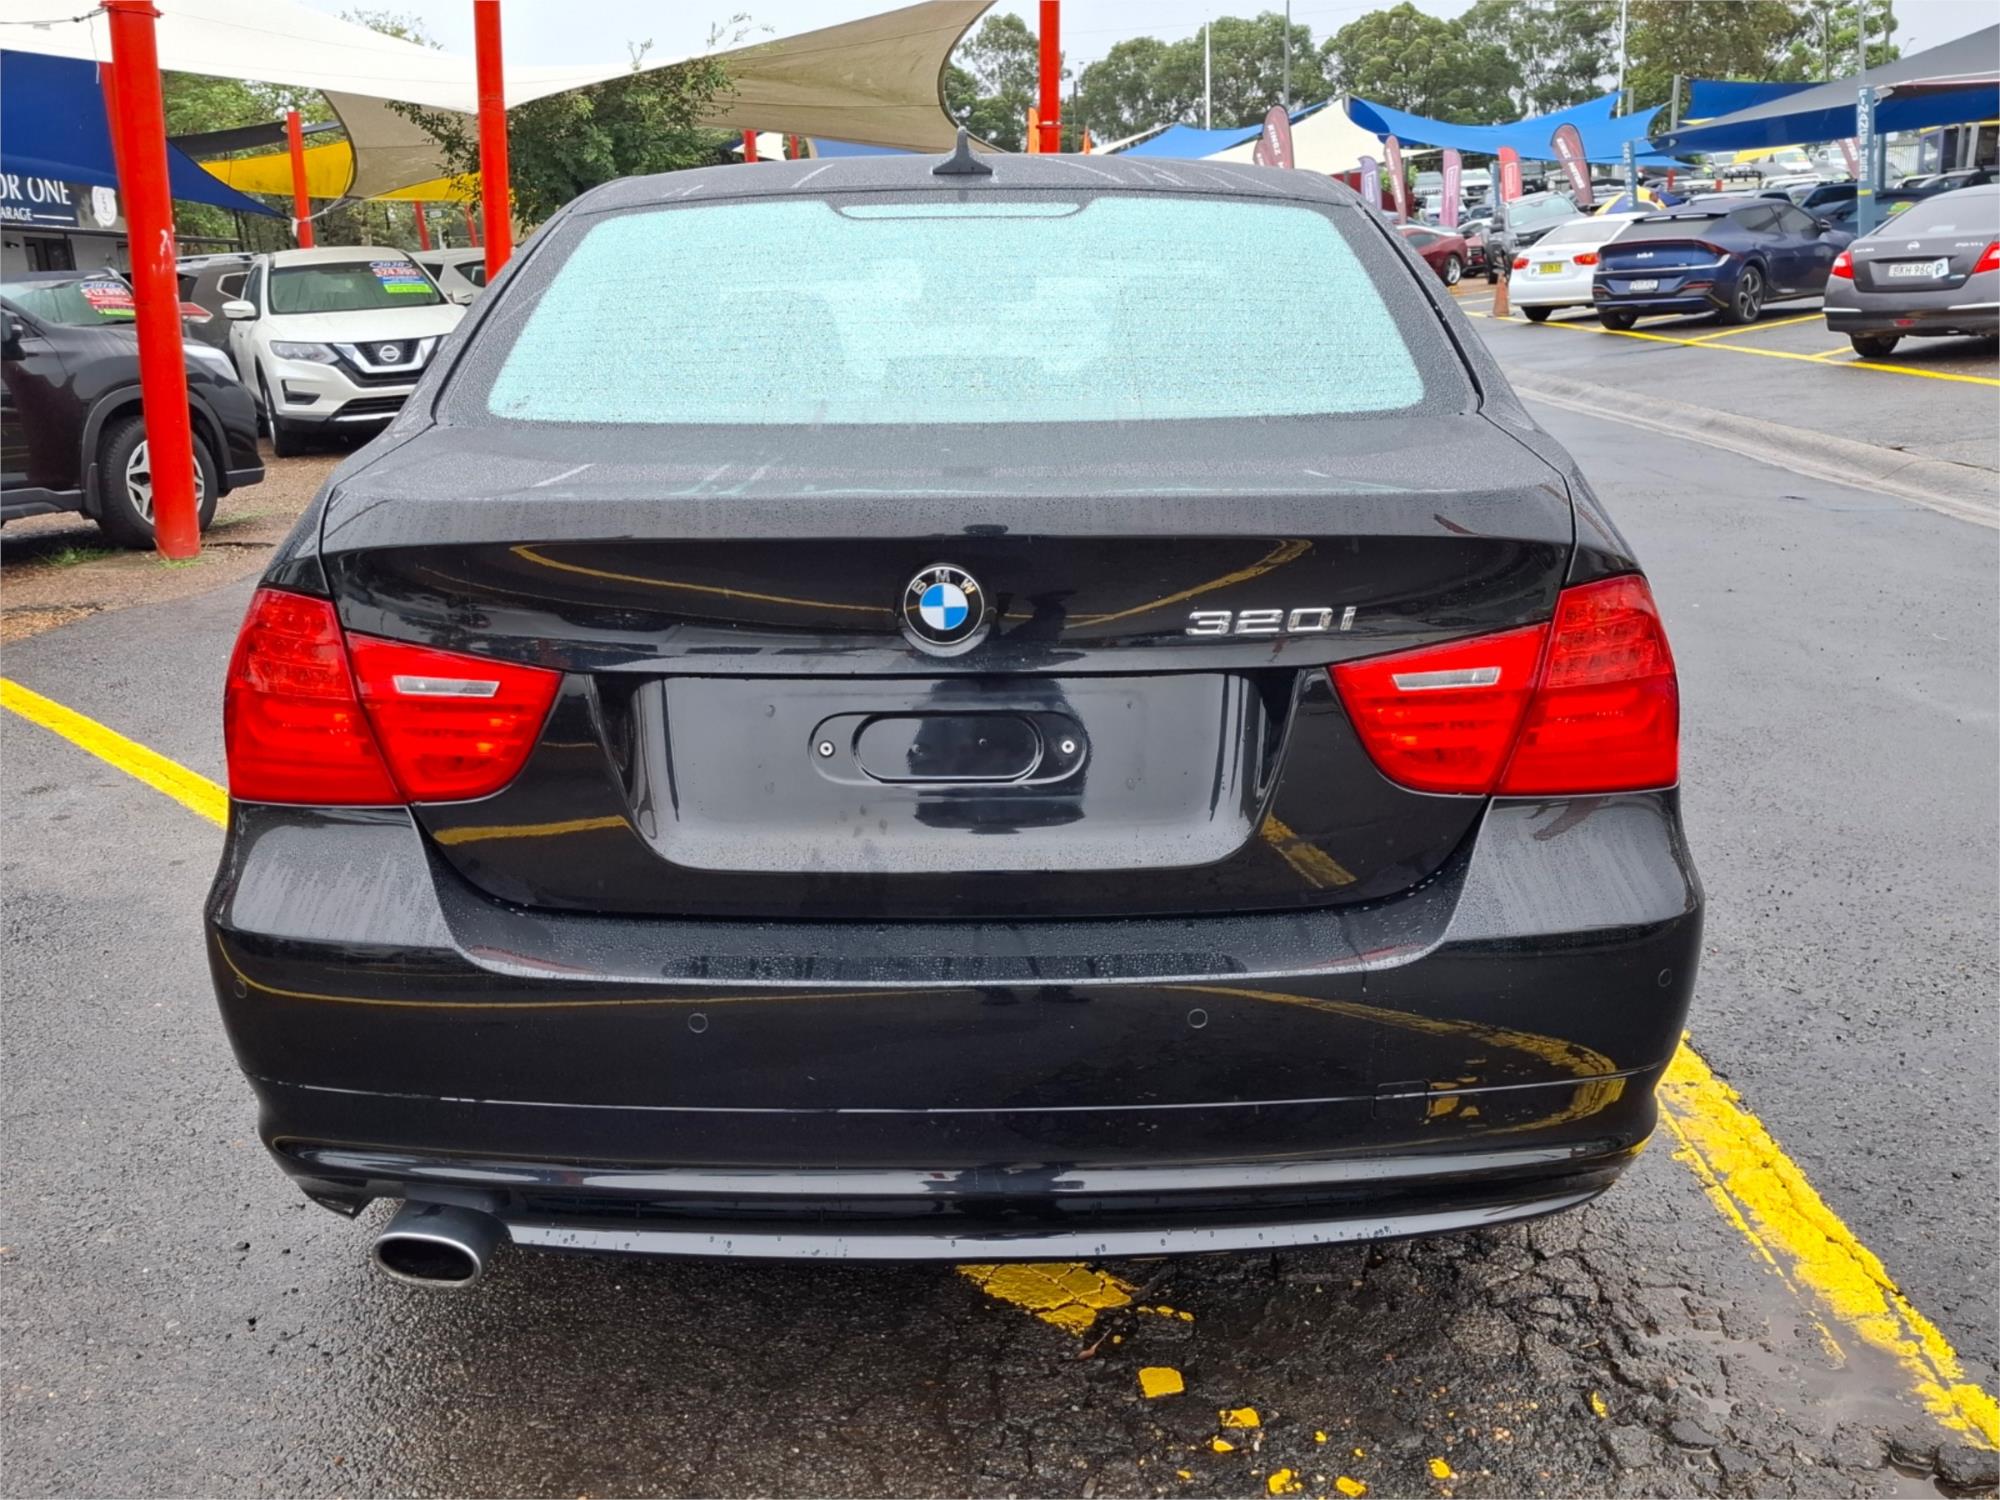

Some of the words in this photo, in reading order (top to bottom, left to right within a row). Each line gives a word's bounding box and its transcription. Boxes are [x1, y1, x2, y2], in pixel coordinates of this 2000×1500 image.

[1858, 88, 1869, 144] FINANCE
[27, 177, 72, 205] ONE
[911, 568, 977, 596] BMW
[1186, 606, 1357, 635] 320i
